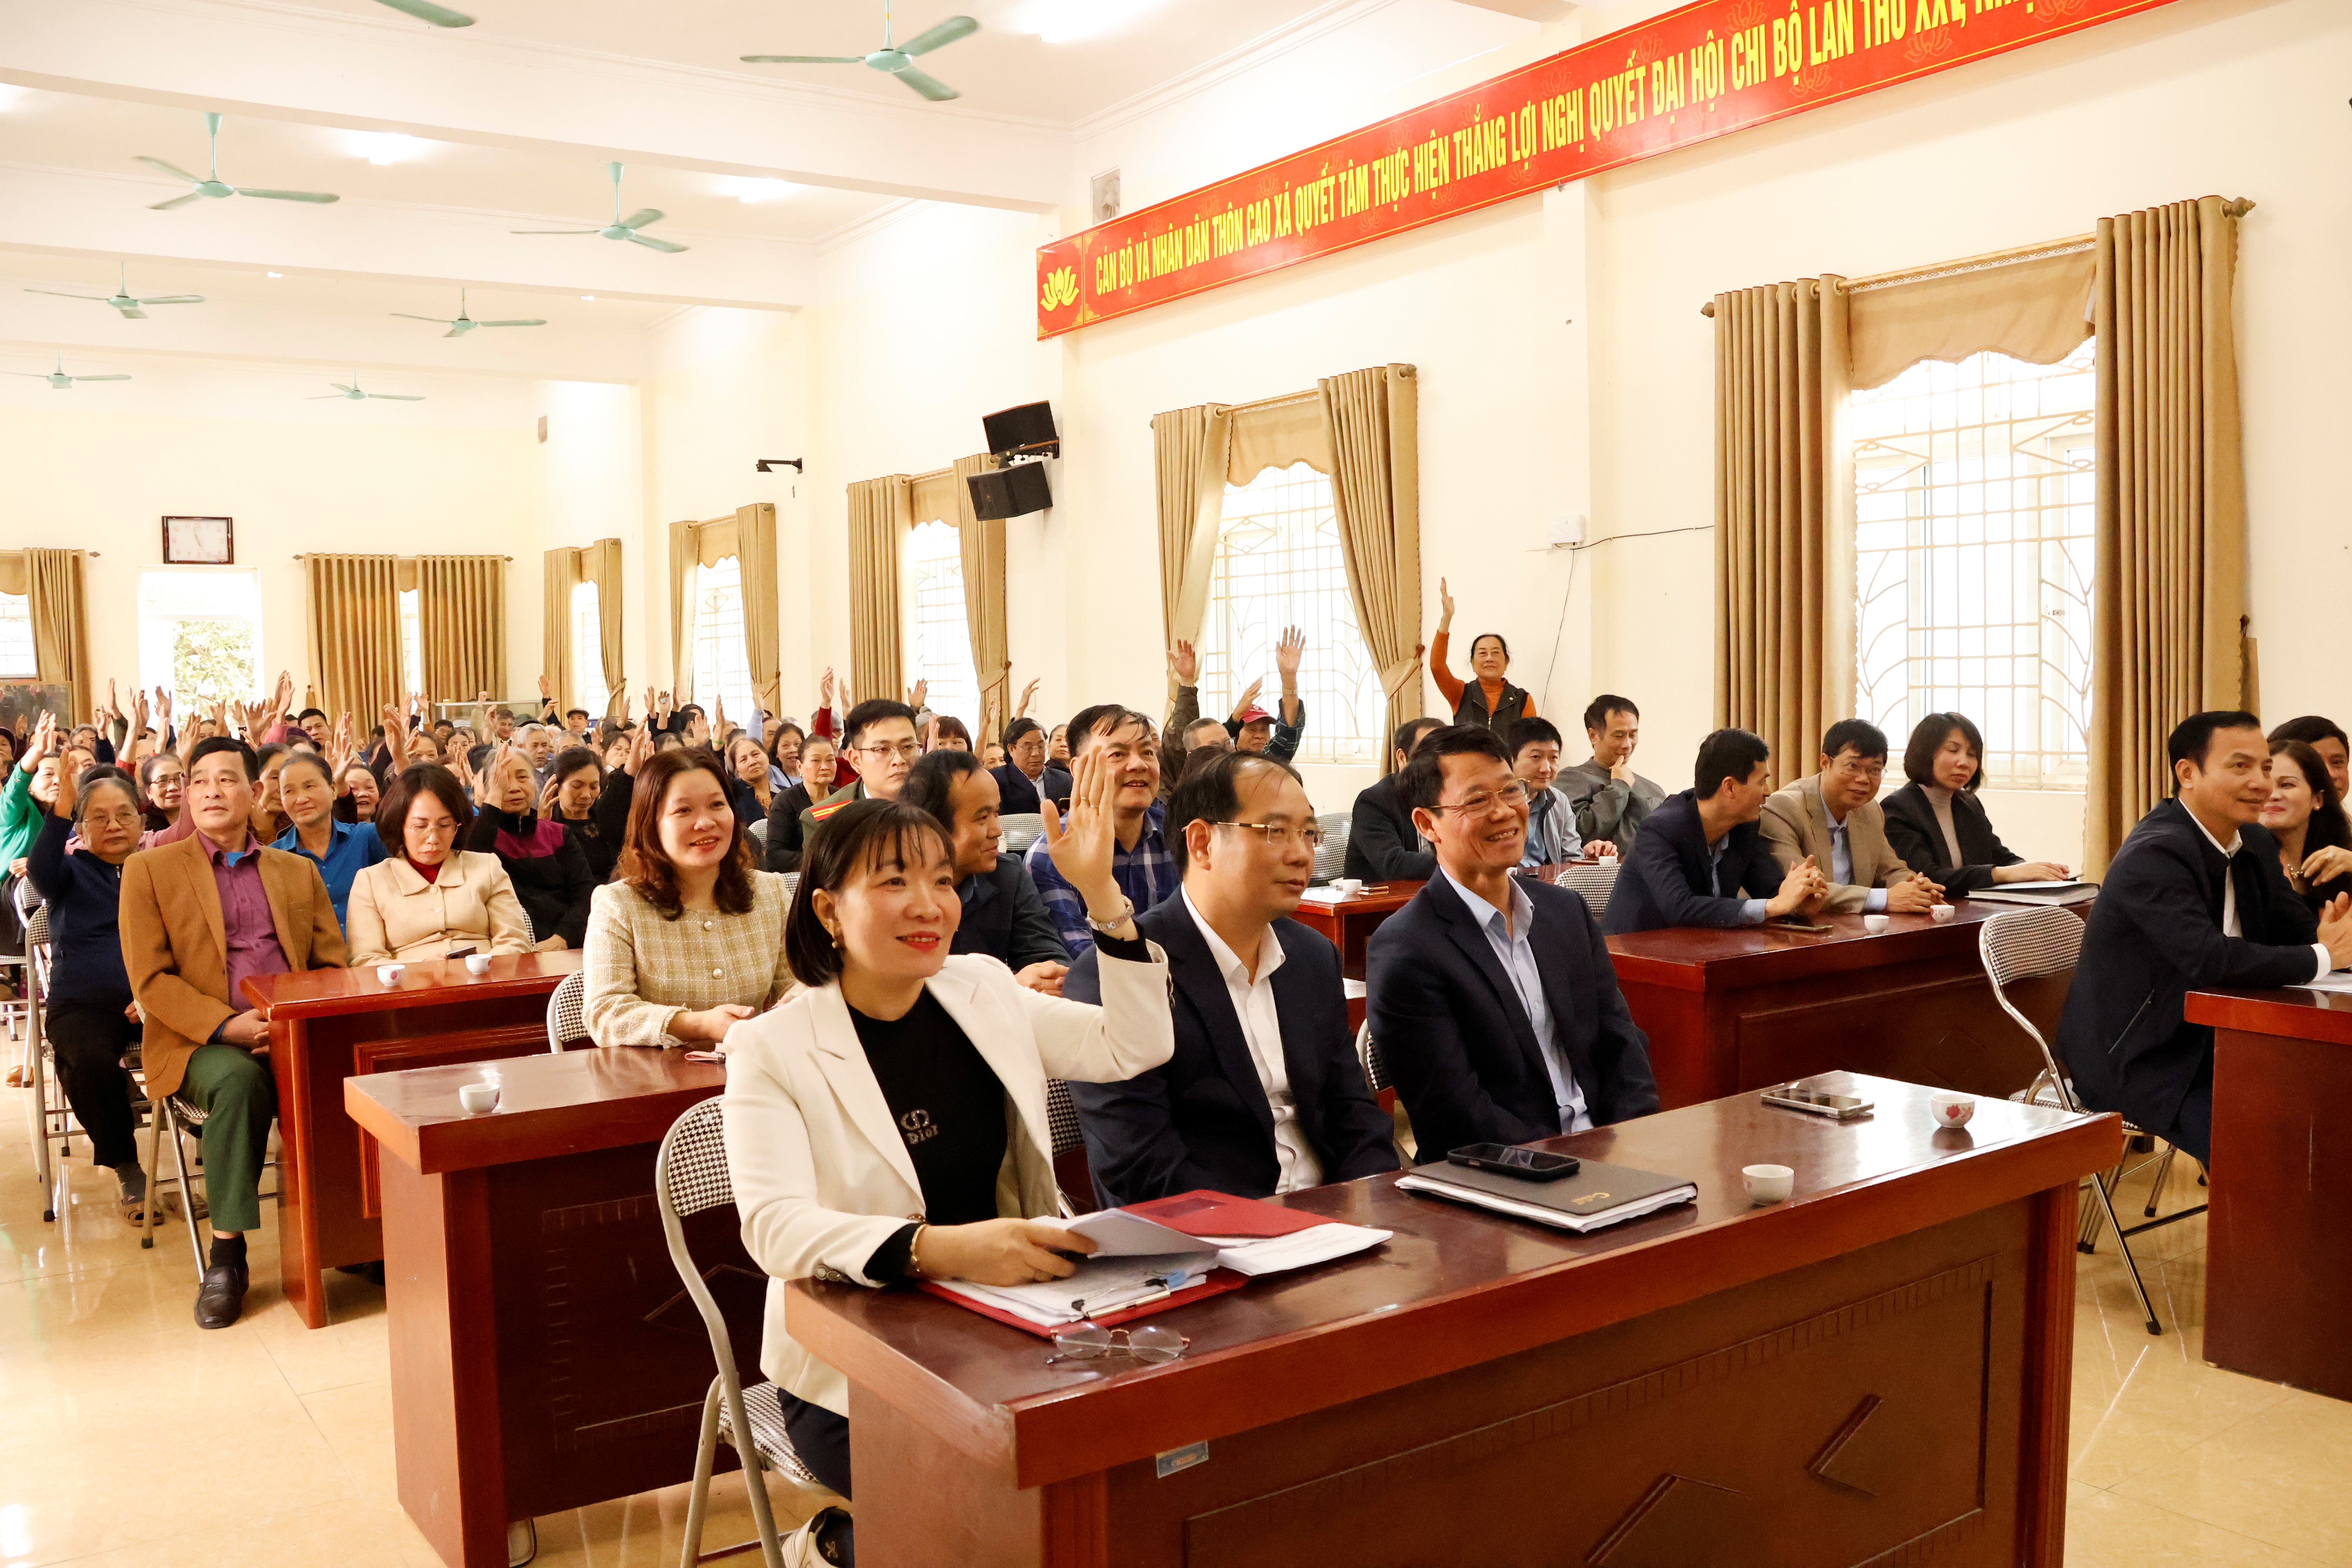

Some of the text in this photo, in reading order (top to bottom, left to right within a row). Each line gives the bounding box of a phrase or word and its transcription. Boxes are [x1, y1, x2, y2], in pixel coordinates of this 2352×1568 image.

[1096, 245, 1117, 296] CÁN
[1119, 237, 1133, 295] BỘ
[1135, 231, 1149, 282] VÀ
[1152, 223, 1183, 278] NHÂN
[1185, 213, 1209, 267] DÂN
[1212, 201, 1244, 258] THÔN
[1247, 198, 1271, 248] CAO
[1274, 181, 1292, 239] XÁ
[1295, 162, 1336, 237] QUYẾT
[1338, 159, 1369, 218] TÂM
[1372, 147, 1410, 212] THỰC
[1414, 129, 1450, 200] HIỆN
[1453, 104, 1506, 180] THẮNG
[1511, 100, 1537, 171] LỢI
[1542, 87, 1584, 153] NGHỊ
[1590, 50, 1646, 142] QUYẾT
[1651, 52, 1685, 124] ĐẠI
[1691, 30, 1725, 112] HỘI
[1731, 24, 1766, 91] CHI
[1773, 0, 1802, 86] BỘ
